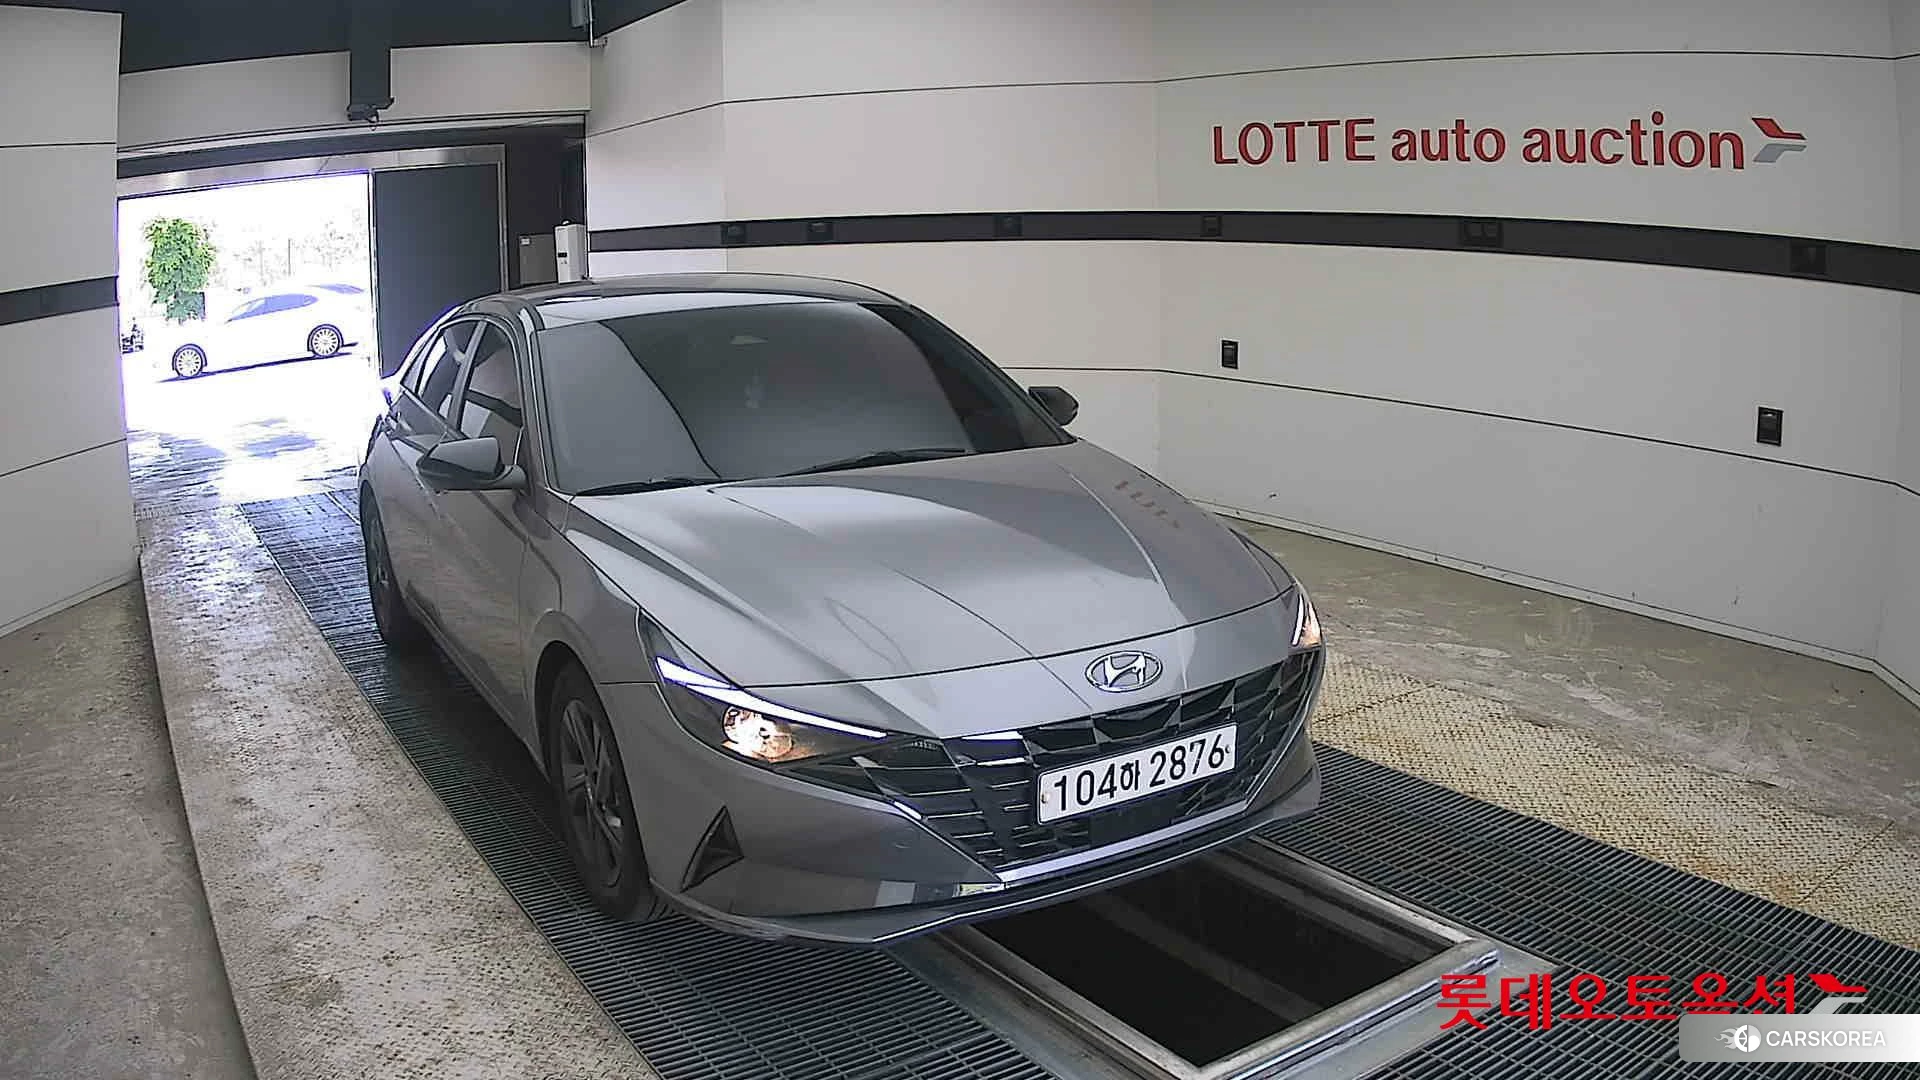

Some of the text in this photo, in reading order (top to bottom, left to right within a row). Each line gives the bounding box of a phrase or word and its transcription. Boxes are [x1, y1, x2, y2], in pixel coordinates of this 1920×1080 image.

[1213, 112, 1745, 169] LOTTE auto auction
[1054, 733, 1226, 811] 104하 2876
